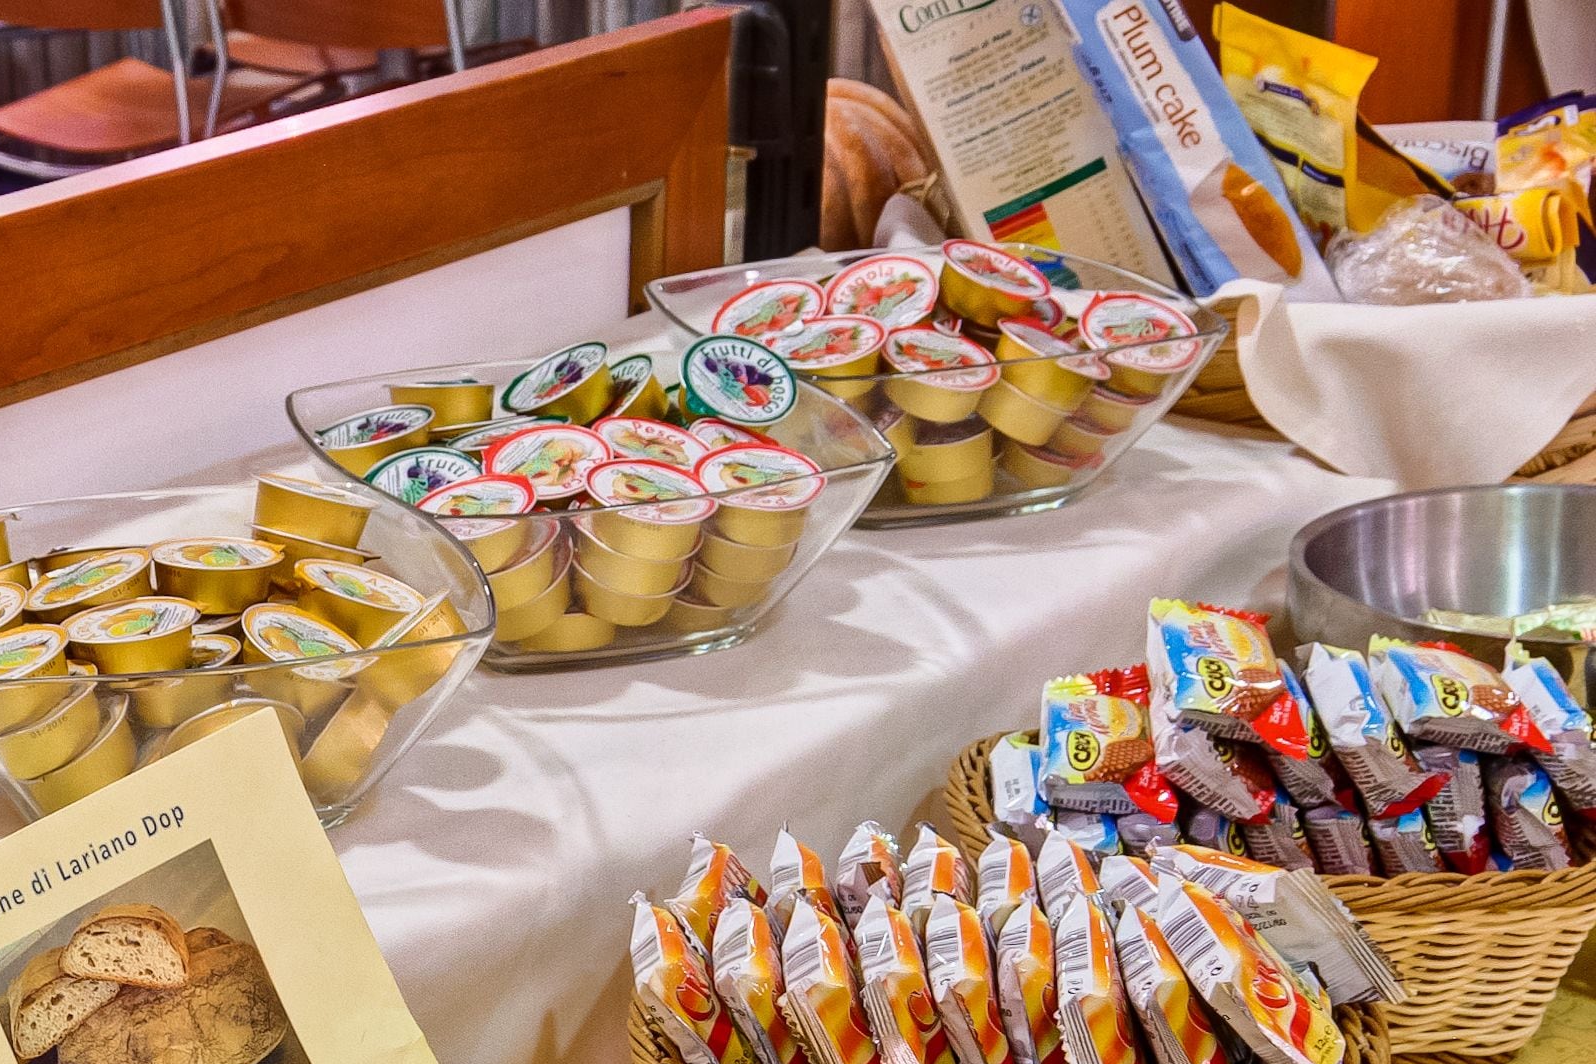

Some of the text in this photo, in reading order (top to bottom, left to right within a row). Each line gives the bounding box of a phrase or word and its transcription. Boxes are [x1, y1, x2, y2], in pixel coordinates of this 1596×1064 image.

[1113, 5, 1164, 81] Plum
[1155, 84, 1201, 149] cake
[701, 344, 788, 415] Frutti di bosco
[416, 455, 469, 478] Frutti
[632, 421, 686, 446] Pesca
[31, 868, 54, 897] di
[59, 829, 139, 883] Lariano
[142, 803, 187, 838] Dop
